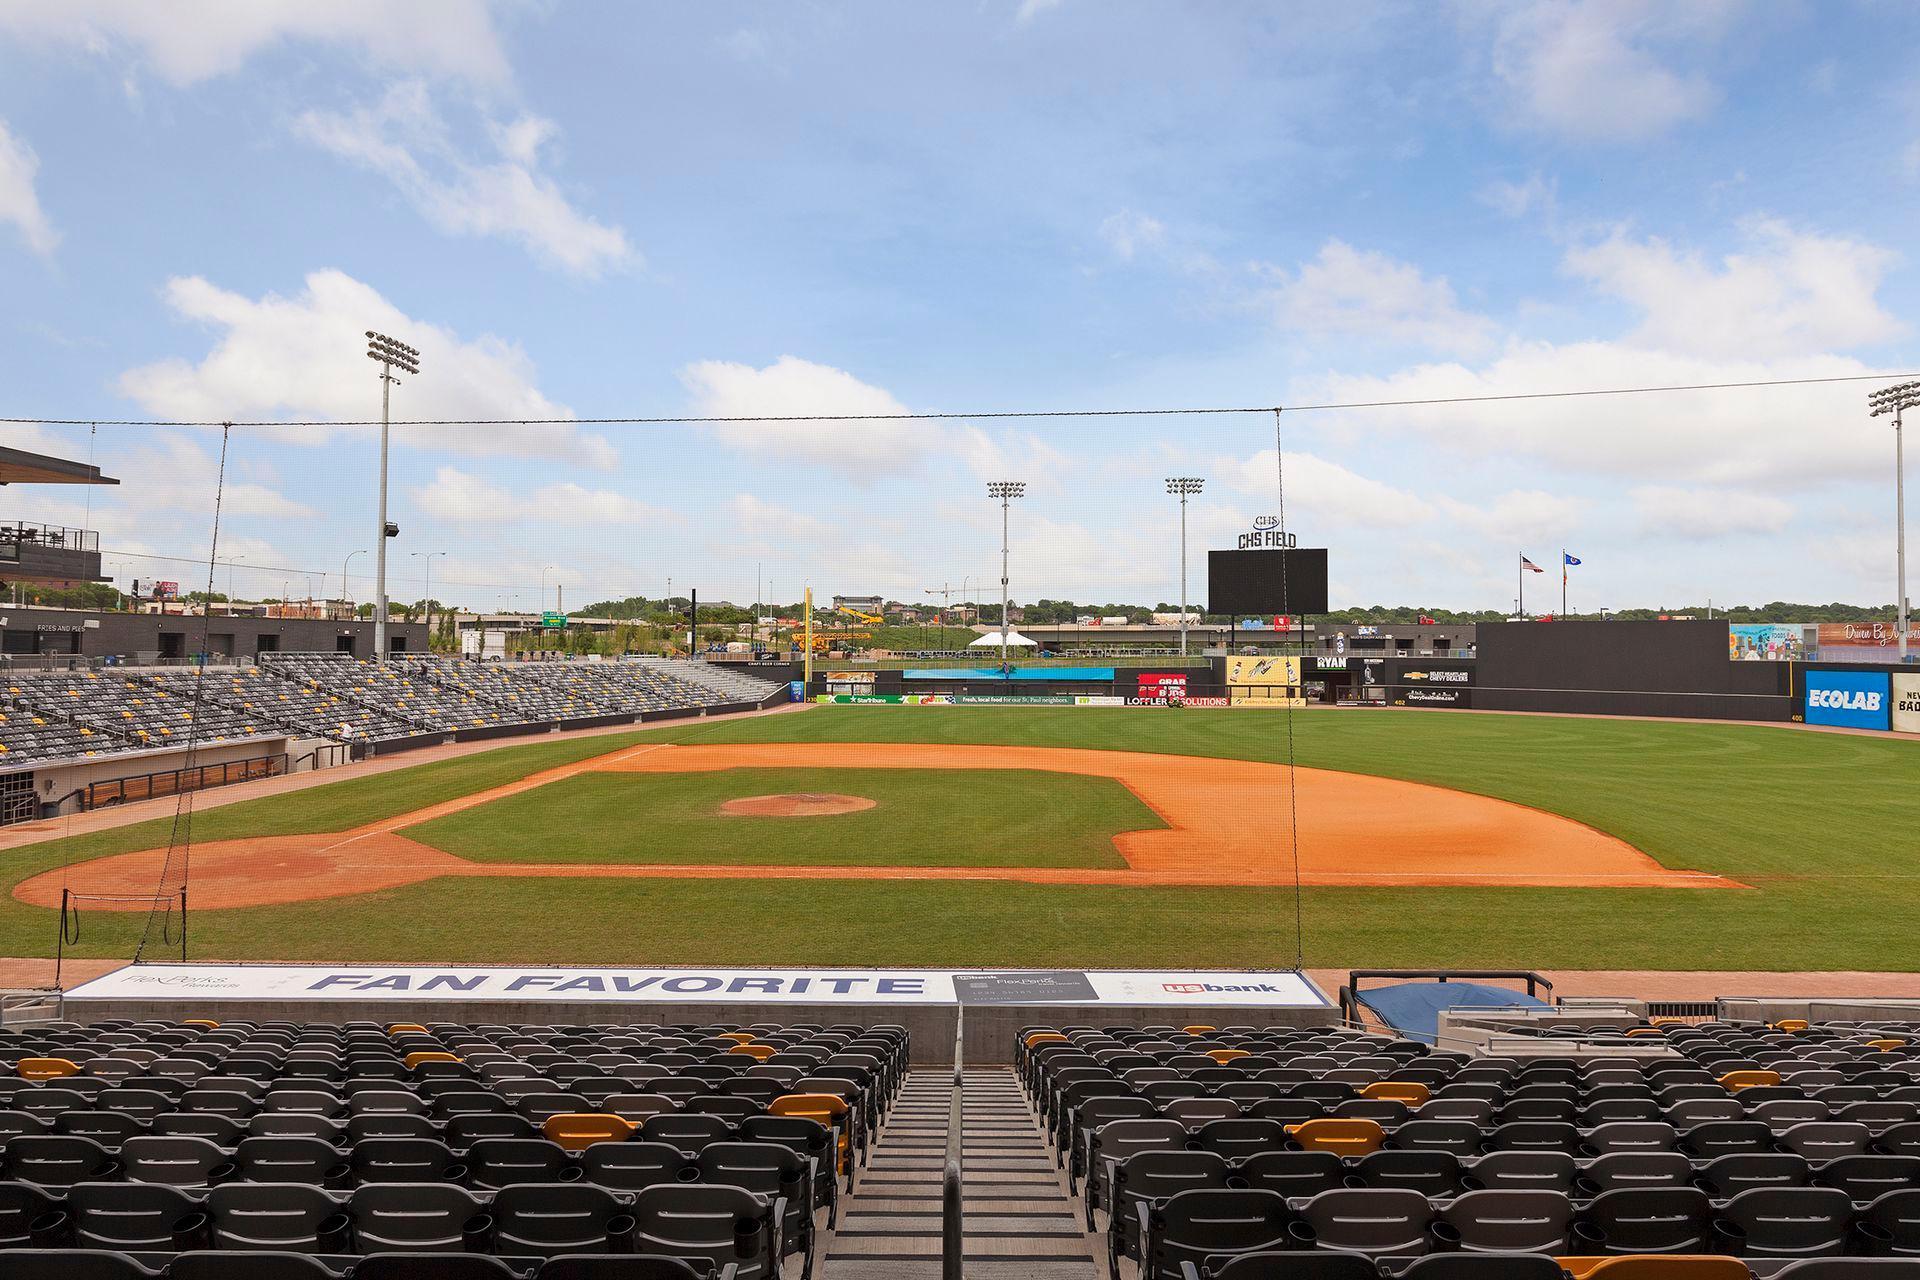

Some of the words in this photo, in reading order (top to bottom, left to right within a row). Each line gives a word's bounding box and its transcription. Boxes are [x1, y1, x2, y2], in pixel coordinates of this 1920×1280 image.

[1255, 515, 1278, 526] CHS
[1238, 531, 1262, 549] CHS
[1265, 531, 1297, 549] FIELD
[37, 624, 57, 632] FRIES
[72, 625, 86, 633] PIES
[1843, 624, 1873, 640] Driven
[1873, 623, 1889, 646] By
[1316, 656, 1347, 668] RYAN
[1126, 697, 1168, 706] LOFFLER
[1181, 697, 1228, 706] SOLUTIONS
[1809, 689, 1881, 711] ECOLAB
[1791, 714, 1803, 722] 400
[121, 975, 228, 985] FlexPerks
[306, 974, 490, 991] FAN
[503, 975, 925, 994] FAVORITE
